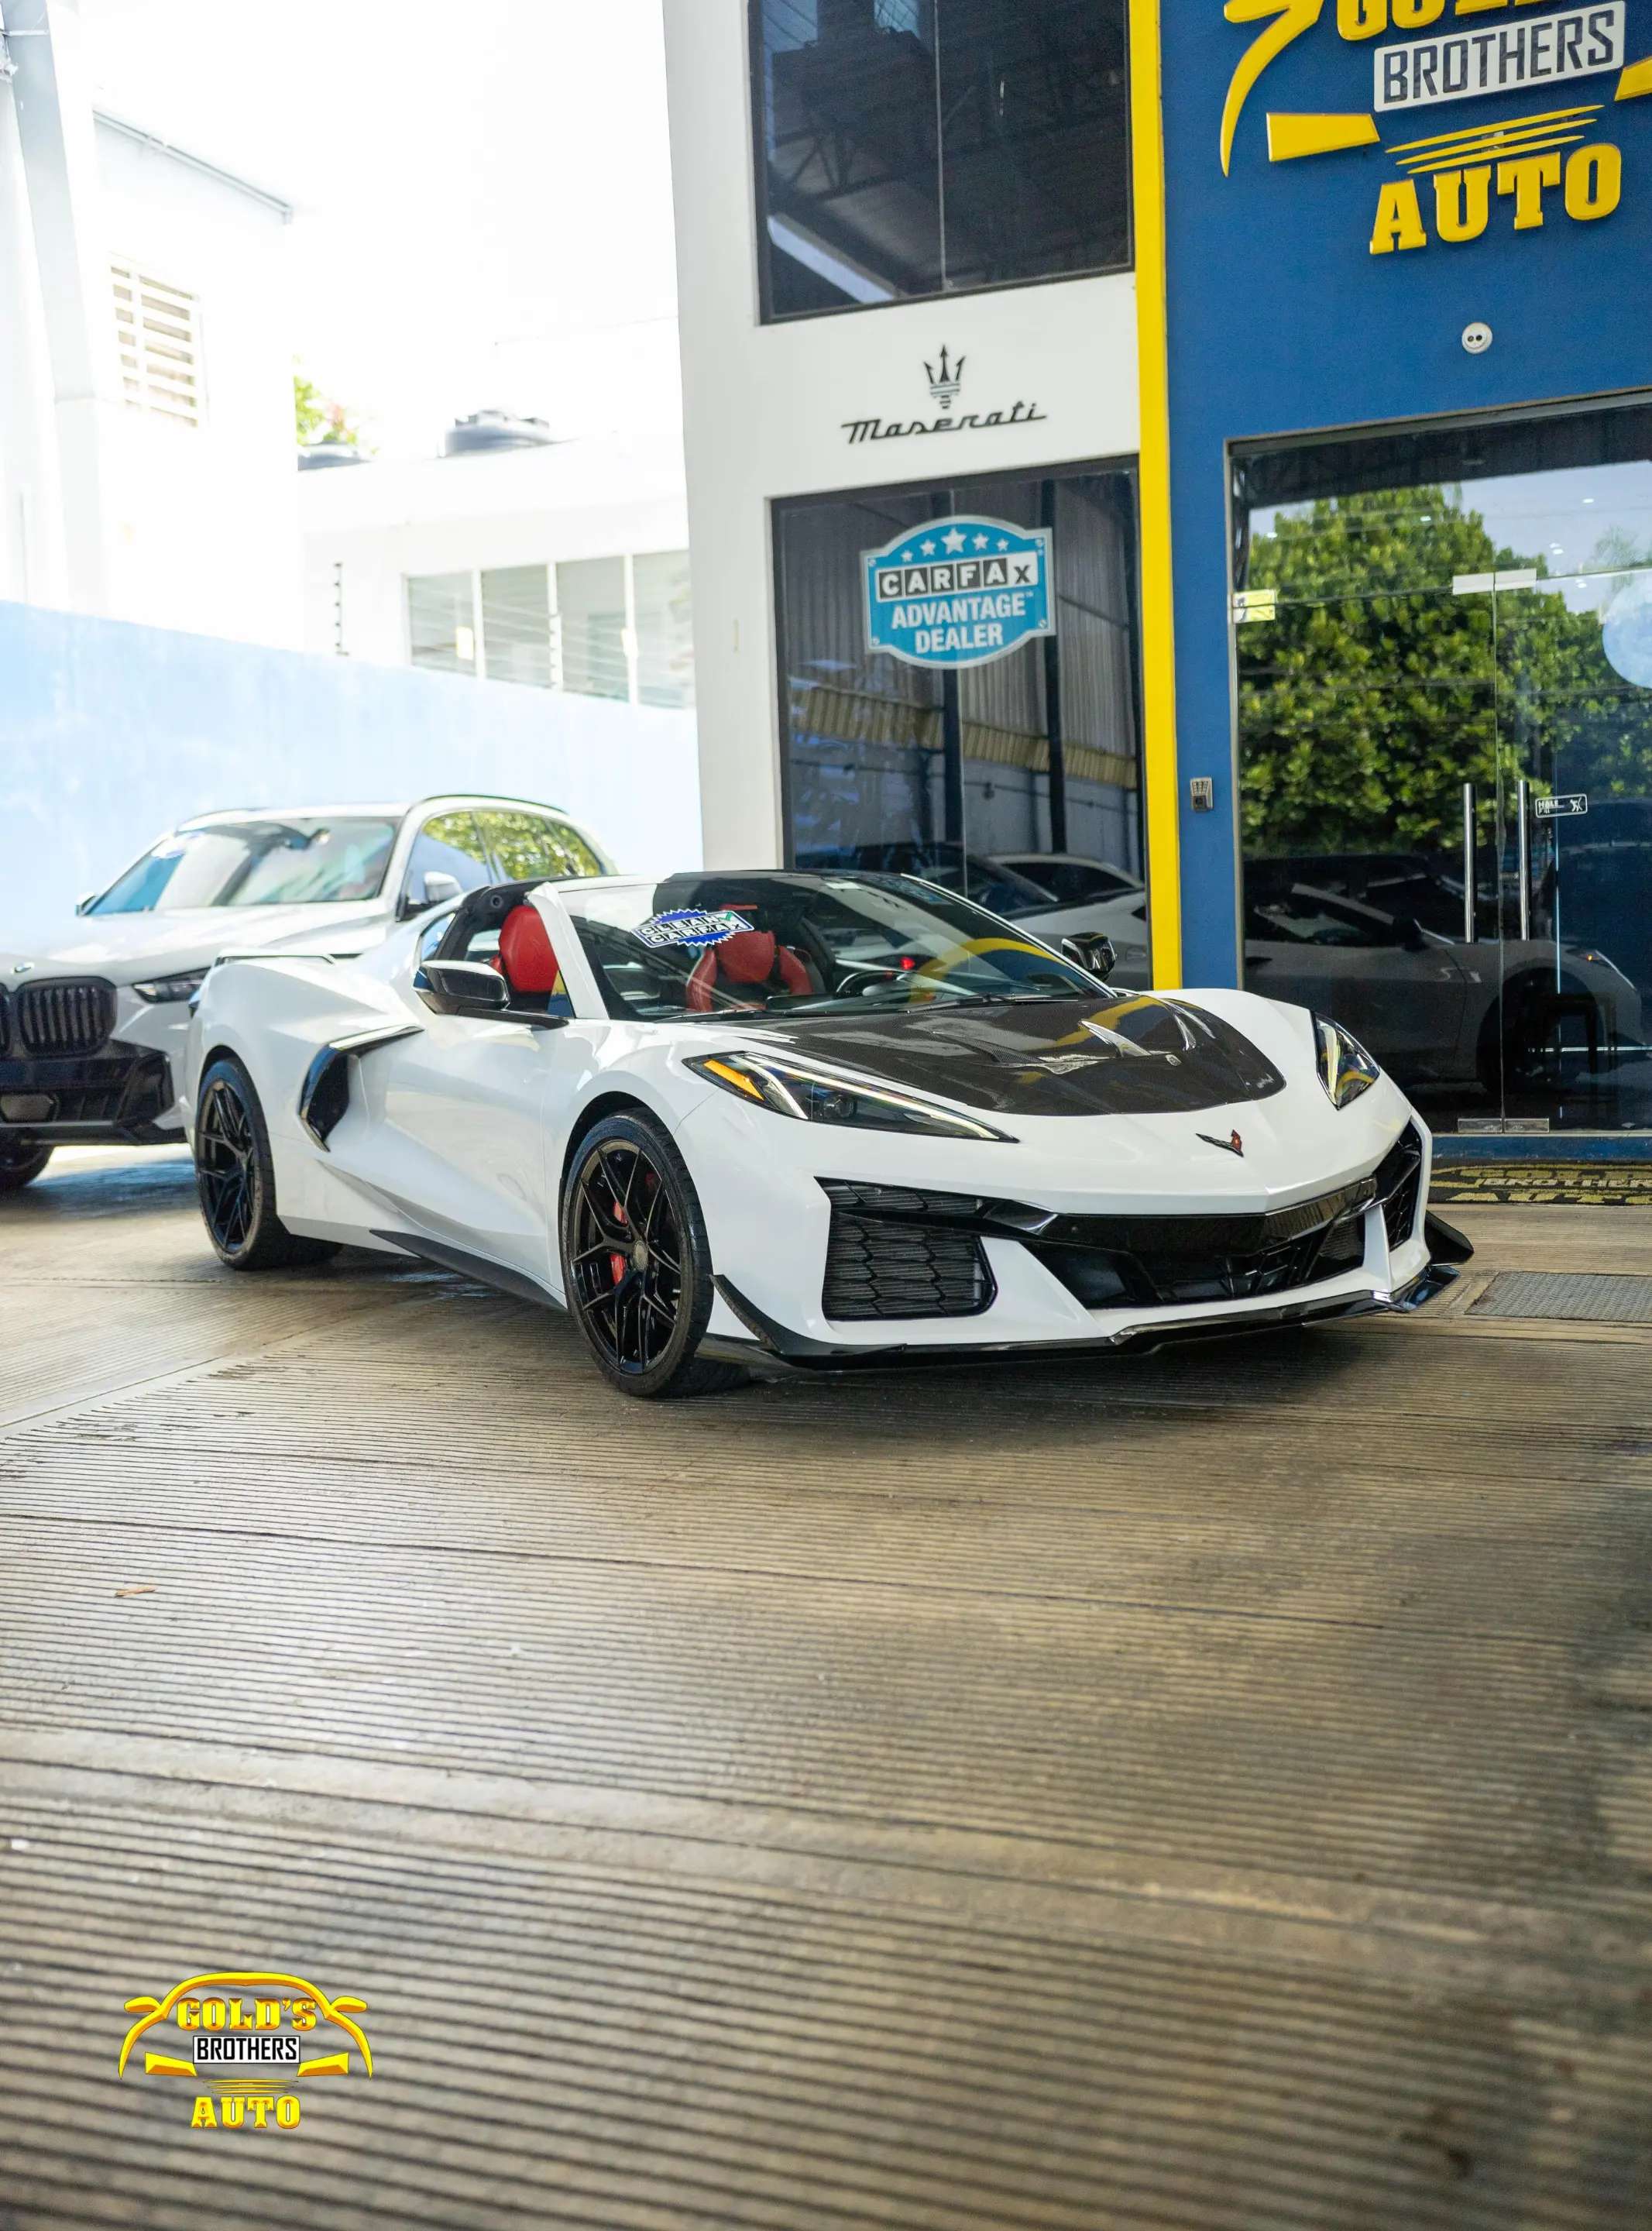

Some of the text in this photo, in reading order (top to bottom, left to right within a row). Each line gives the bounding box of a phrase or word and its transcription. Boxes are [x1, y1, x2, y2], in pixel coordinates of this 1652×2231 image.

[1383, 9, 1615, 104] BROTHERS
[1369, 143, 1623, 255] AUTO
[841, 400, 1046, 444] Maserati
[881, 562, 1031, 596] CARFAX
[915, 623, 1004, 654] DEALER
[641, 916, 720, 935] CLEAN
